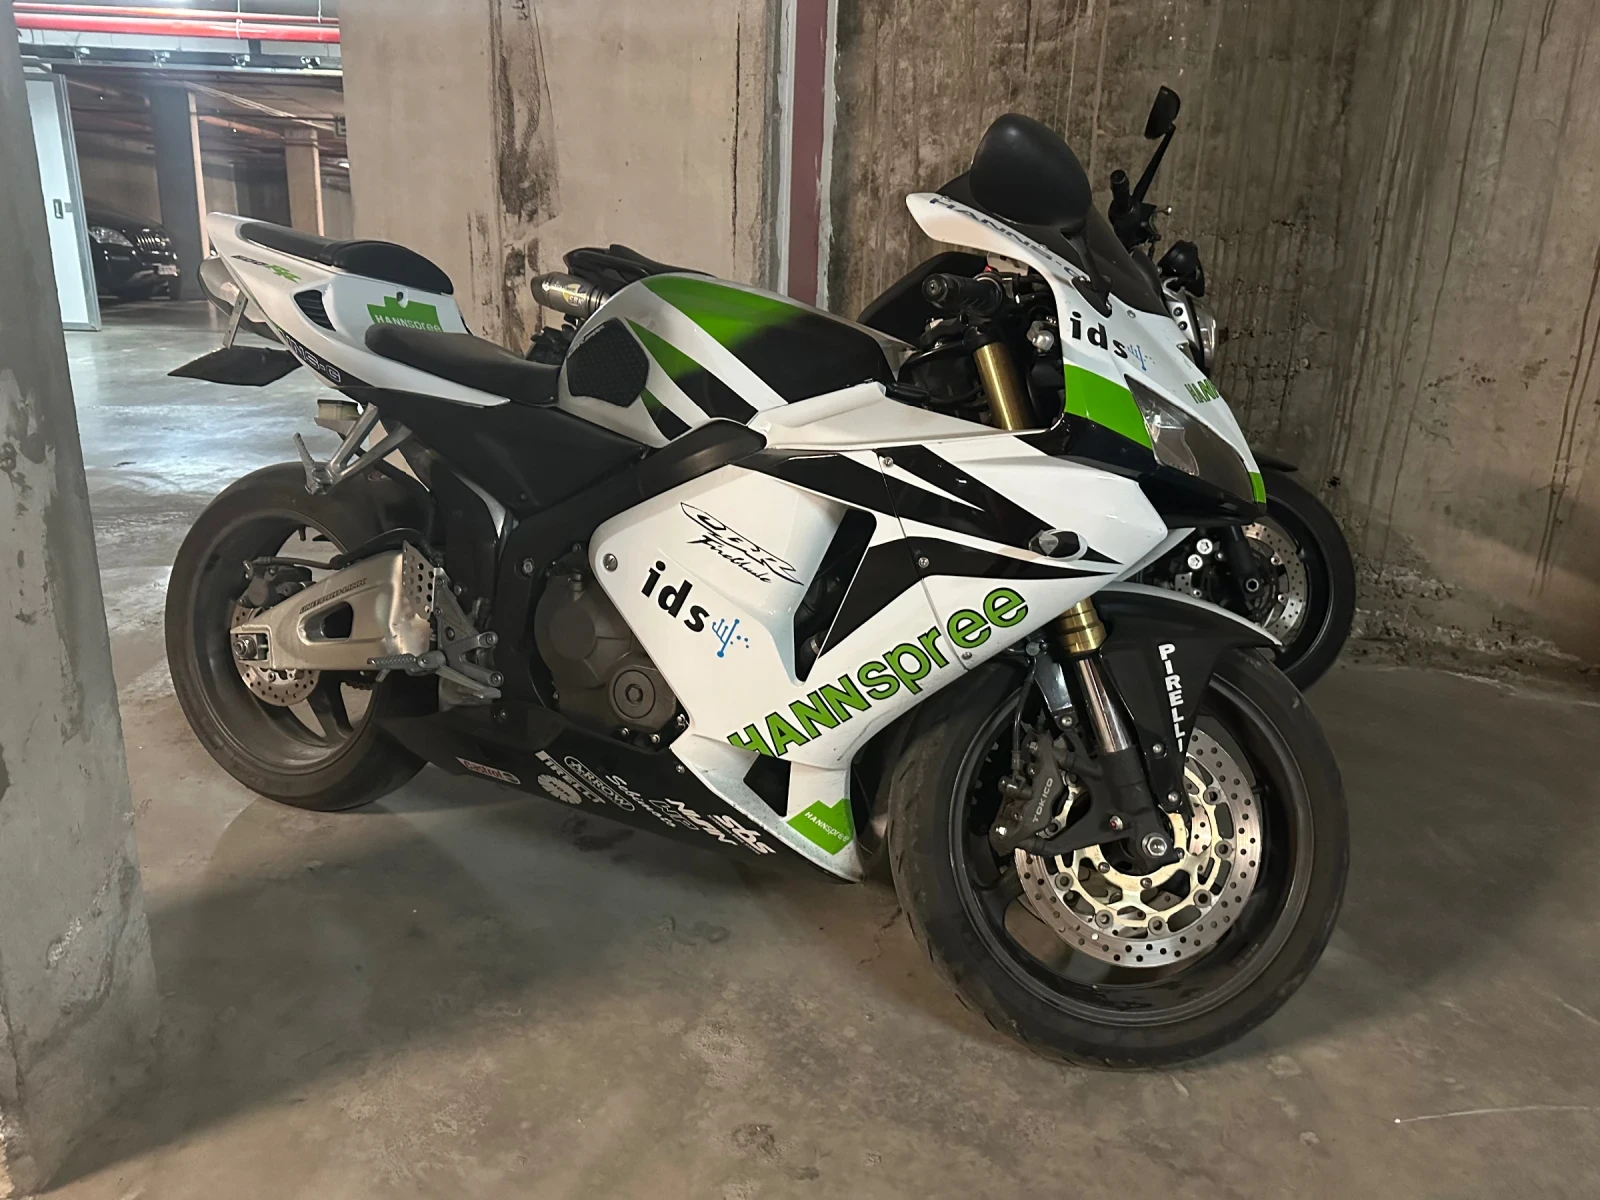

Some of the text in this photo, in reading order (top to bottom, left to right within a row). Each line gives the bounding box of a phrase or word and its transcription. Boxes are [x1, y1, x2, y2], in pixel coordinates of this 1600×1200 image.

[1070, 311, 1128, 359] ids
[641, 560, 711, 633] ids
[1158, 643, 1186, 753] PIRELLI
[1032, 777, 1054, 823] TOKICO
